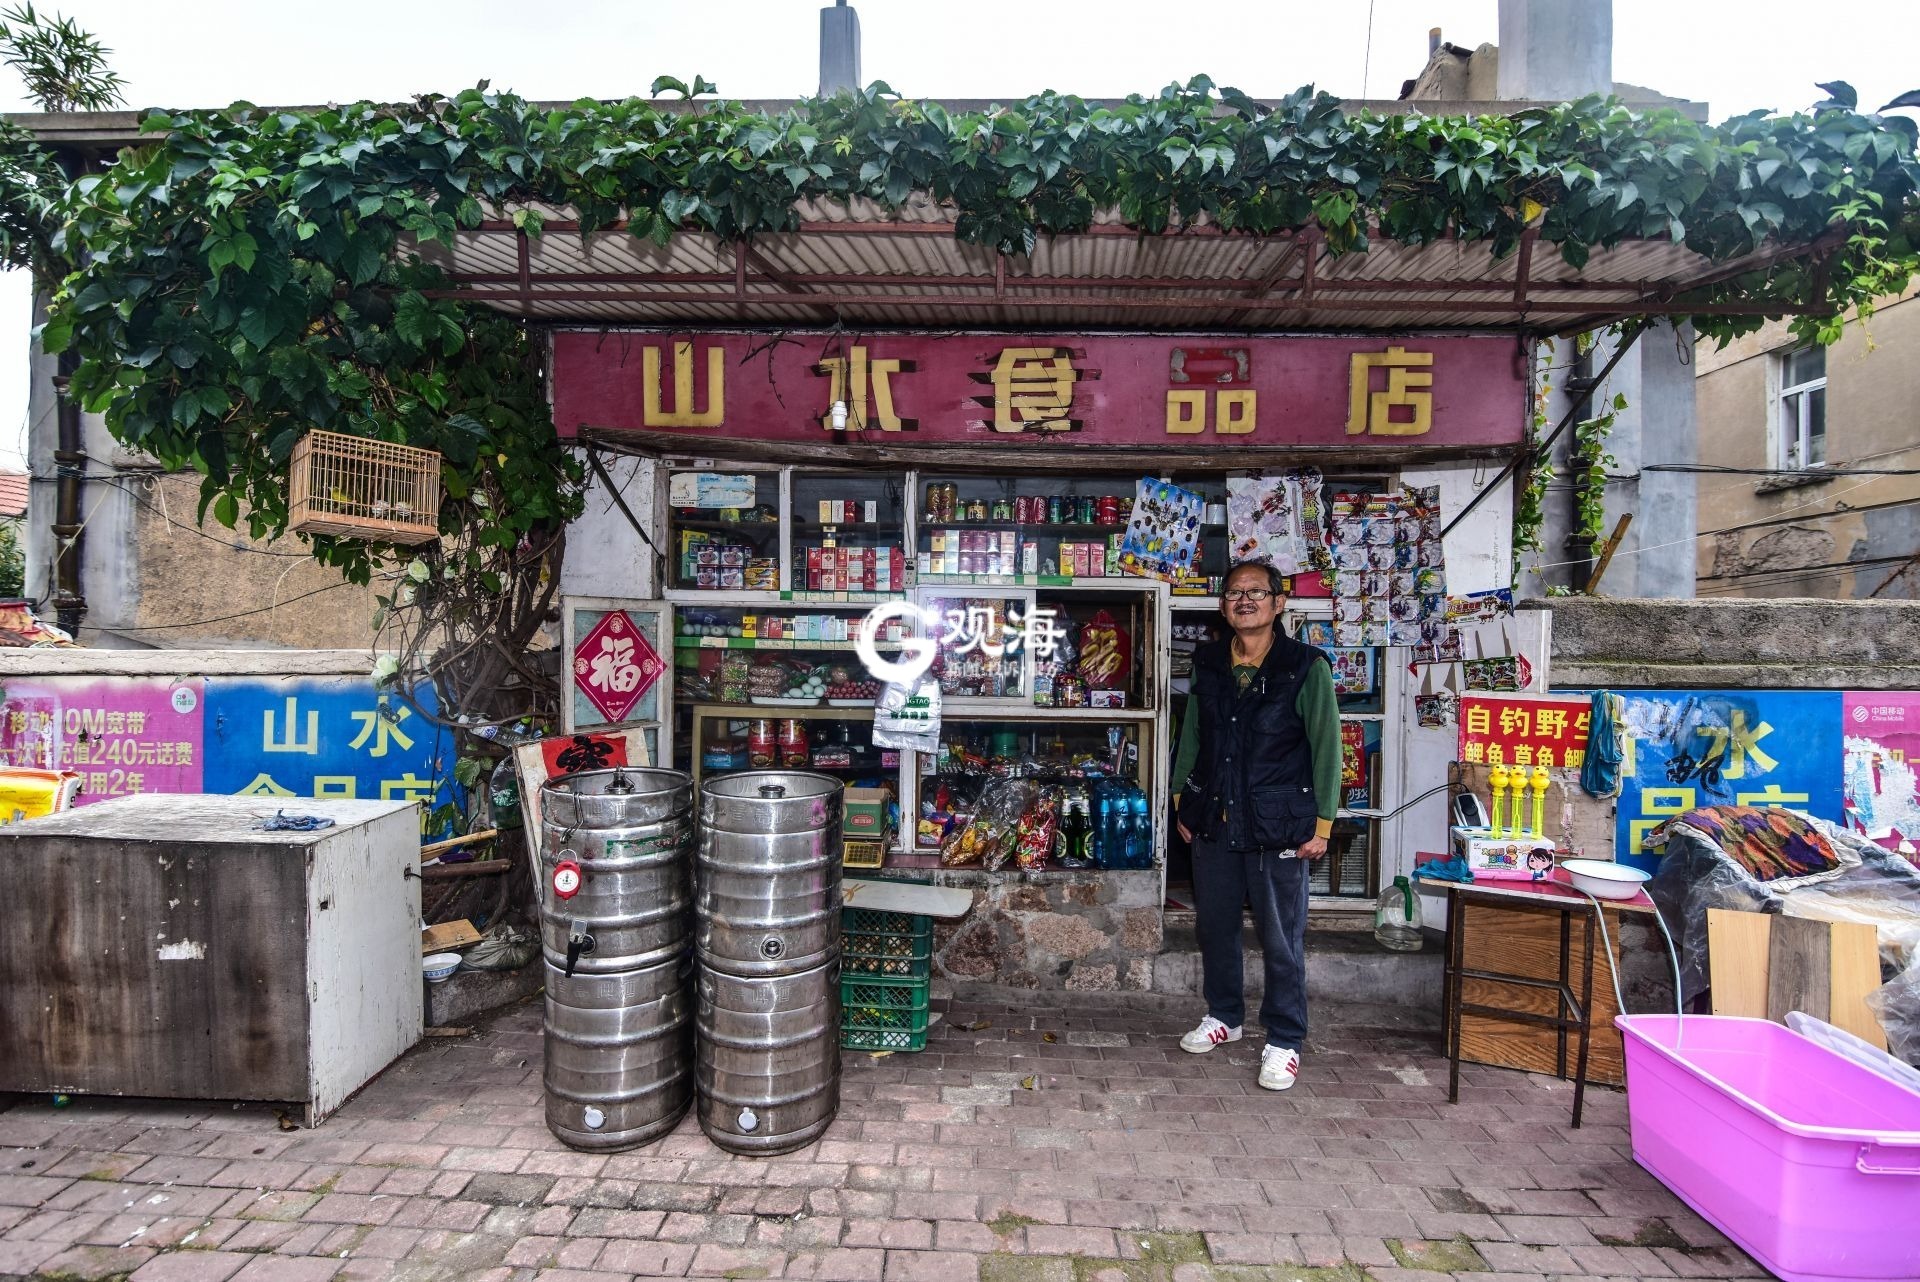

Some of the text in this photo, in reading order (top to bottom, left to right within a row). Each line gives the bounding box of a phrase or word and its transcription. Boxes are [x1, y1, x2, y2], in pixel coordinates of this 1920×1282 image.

[643, 341, 1433, 436] 山水食品店
[589, 636, 641, 693] 福
[263, 696, 415, 757] 山水
[1871, 706, 1905, 715] 中国移动
